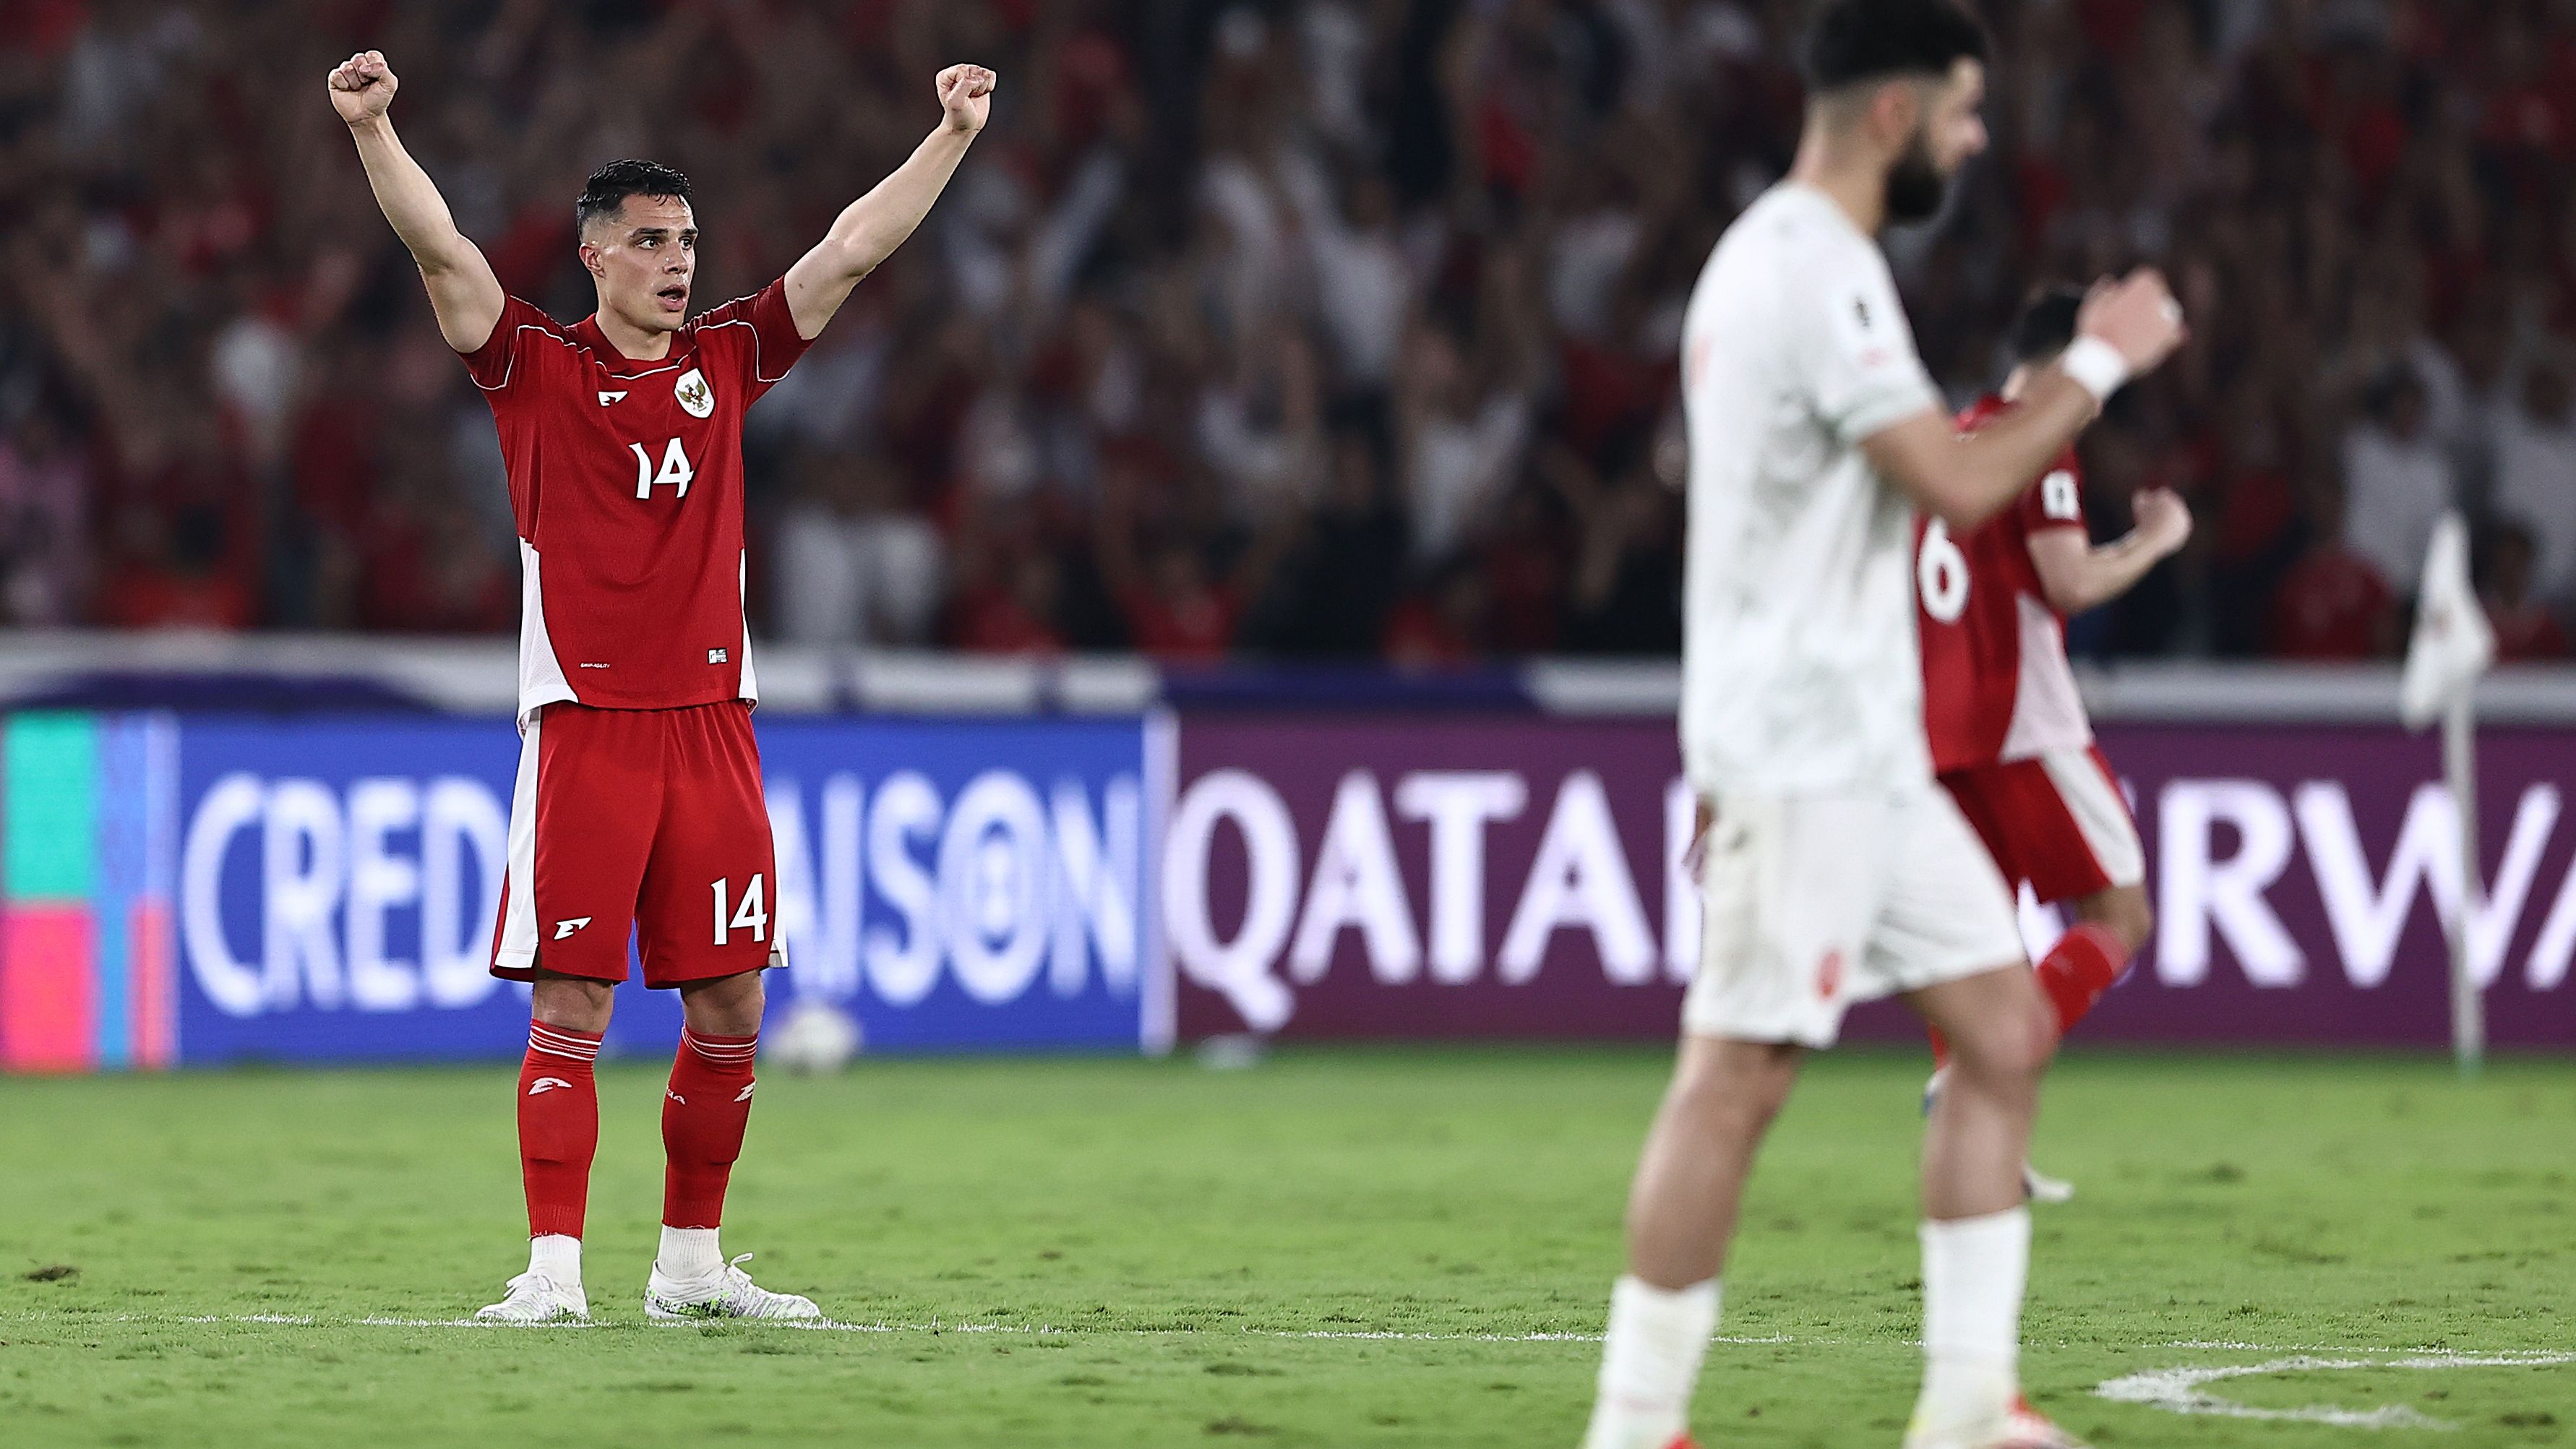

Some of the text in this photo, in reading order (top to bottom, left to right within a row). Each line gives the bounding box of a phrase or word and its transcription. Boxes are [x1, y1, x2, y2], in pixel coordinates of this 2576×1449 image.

[629, 437, 694, 499] 14
[1917, 515, 1972, 624] 6
[182, 769, 1140, 1013] CRED AISON
[711, 873, 768, 945] 14
